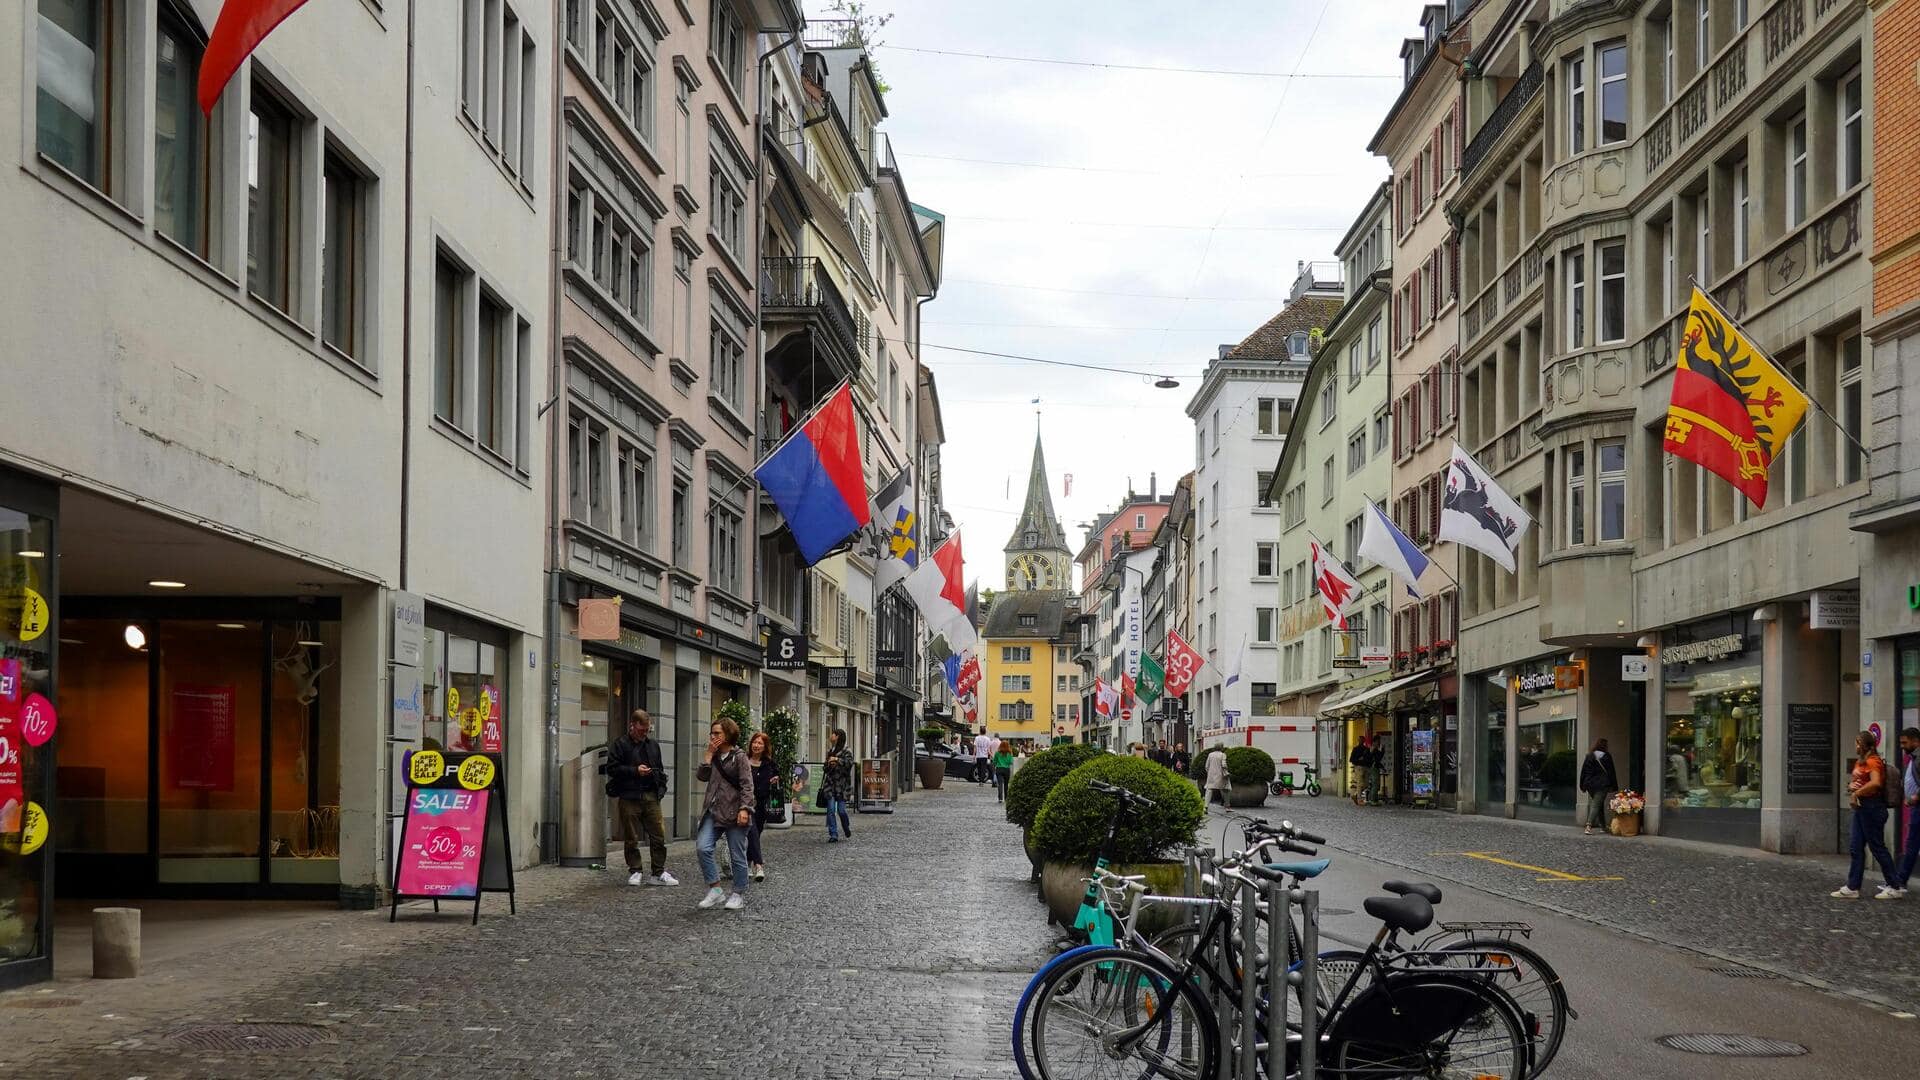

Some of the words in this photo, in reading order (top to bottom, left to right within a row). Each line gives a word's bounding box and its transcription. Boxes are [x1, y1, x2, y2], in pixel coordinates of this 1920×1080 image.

[1130, 599, 1139, 641] HOTEL
[1520, 672, 1555, 690] PostFinance
[24, 705, 48, 736] 70%
[415, 771, 437, 779] SALE
[463, 775, 485, 786] SALE
[413, 793, 473, 810] SALE!
[429, 835, 456, 855] 50%
